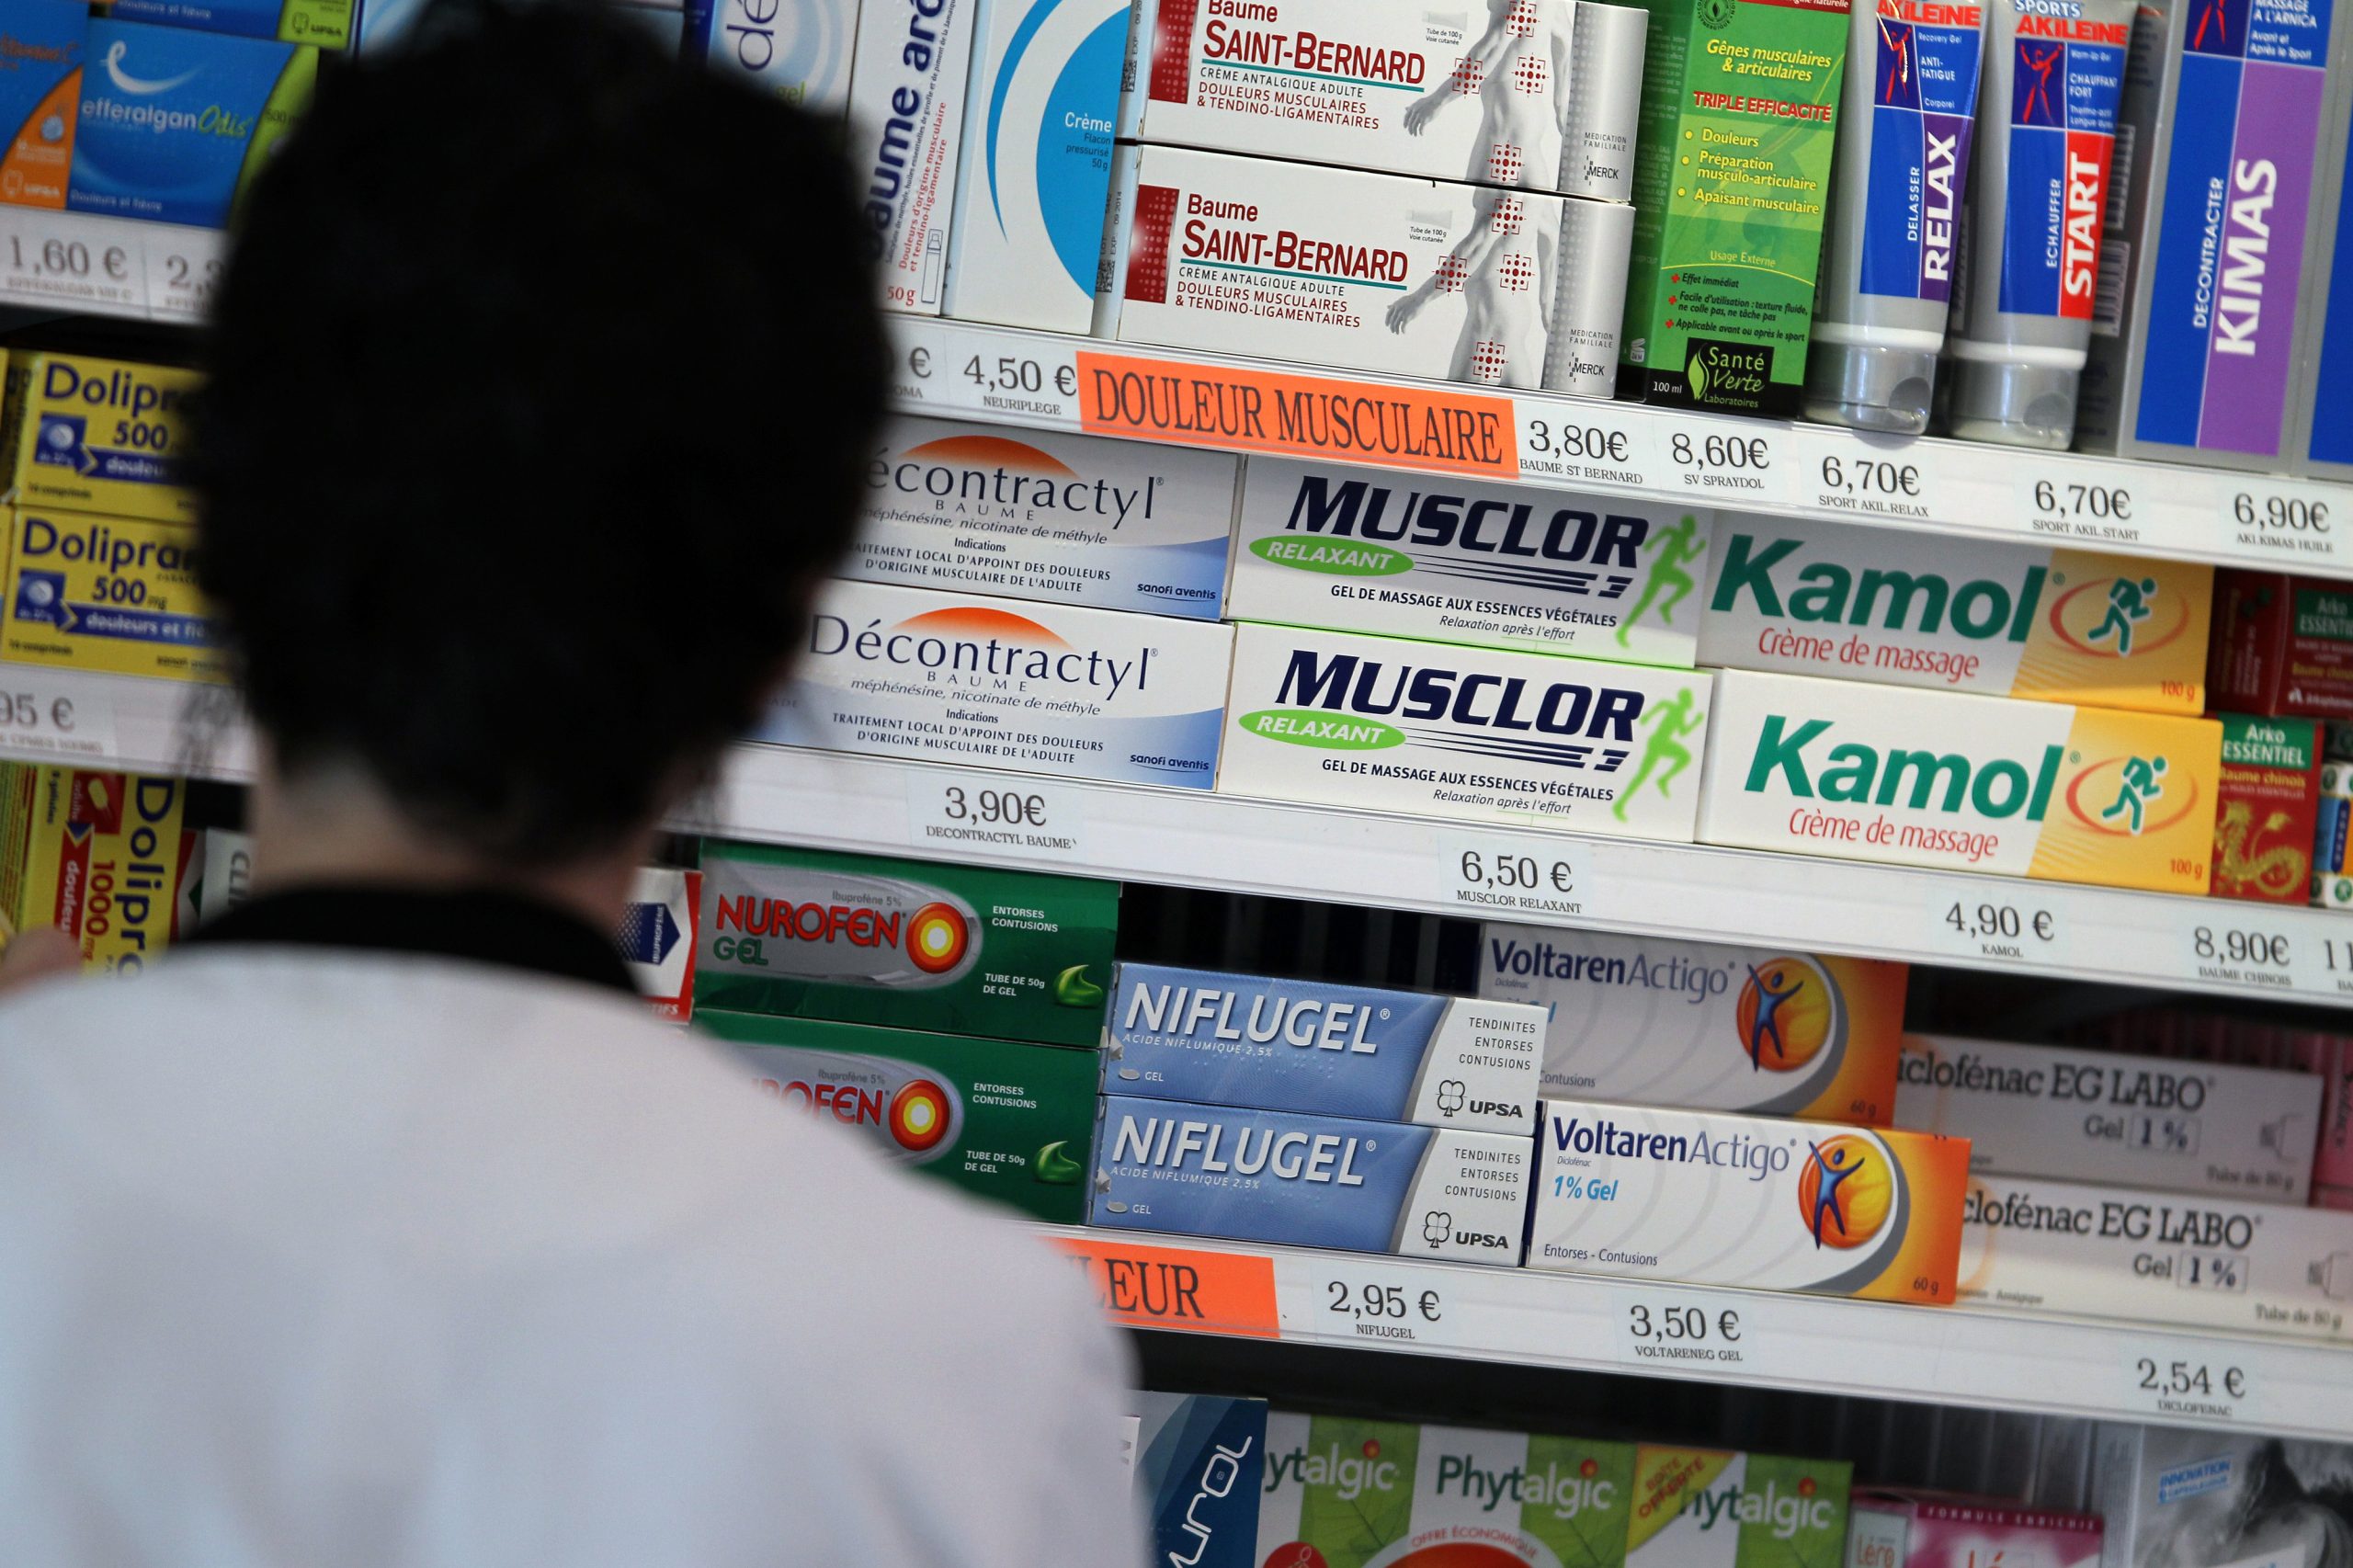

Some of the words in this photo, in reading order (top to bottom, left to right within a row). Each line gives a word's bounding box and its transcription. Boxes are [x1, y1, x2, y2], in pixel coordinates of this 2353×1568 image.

[1203, 20, 1426, 85] SAINT-BERNARD
[1707, 39, 1750, 60] Gênes
[1753, 48, 1832, 68] musculaires
[1722, 58, 1733, 72] &
[1735, 59, 1812, 82] articulaires
[1921, 69, 1955, 82] FATIGUE
[1693, 90, 1745, 111] TRIPLE
[1746, 97, 1833, 122] EFFICACITÉ
[1065, 112, 1112, 132] Crème
[1066, 145, 1108, 156] pressurisé
[1085, 132, 1110, 144] Flacon
[1702, 128, 1759, 147] Douleurs
[1699, 151, 1773, 173] Préparation
[899, 216, 919, 269] Douleurs
[926, 102, 946, 164] musculaire
[1697, 165, 1816, 191] musculo-articulaire
[1187, 193, 1258, 222] Baume
[1694, 188, 1750, 209] Apaisant
[1753, 196, 1819, 215] musculaire
[1906, 165, 1921, 242] DELASSER
[1924, 131, 1957, 282] RELAX
[2046, 178, 2062, 268] ECHAUFFER
[2065, 151, 2100, 299] START
[11, 235, 90, 275] 1,60
[103, 246, 128, 280] €
[910, 259, 916, 272] et
[1182, 218, 1408, 284] SAINT-BERNARD
[1710, 250, 1737, 265] Usage
[1740, 251, 1776, 268] Externe
[2193, 176, 2224, 329] DECONTRACTER
[2215, 157, 2278, 357] KIMAS
[1179, 264, 1218, 281] CRÈME
[1222, 271, 1298, 293] ANTALGIQUE
[1301, 281, 1345, 297] ADULTE
[1177, 280, 1251, 301] DOULEURS
[1254, 289, 1347, 313] MUSCULAIRES
[1175, 295, 1185, 308] &
[1188, 297, 1360, 328] TENDINO-LIGAMENTAIRES
[1569, 336, 1613, 349] FAMILIALE
[1570, 328, 1614, 341] MEDICATION
[1573, 362, 1606, 377] MERCK
[1708, 347, 1765, 371] Santé
[963, 354, 1042, 392] 4,50
[1054, 365, 1077, 396] €
[1711, 367, 1765, 393] Verte
[983, 395, 1062, 415] NEURIPLEGE
[1704, 392, 1759, 409] Laboratoires
[1093, 368, 1267, 440] DOULEUR
[1274, 389, 1503, 465] MUSCULAIRE
[1529, 420, 1629, 462] 3,80€
[1672, 433, 1770, 471] 8,60€
[1519, 459, 1563, 475] BAUME
[1566, 463, 1581, 476] ST
[1584, 465, 1643, 484] BERNARD
[1684, 473, 1699, 485] SV
[1703, 475, 1765, 490] SPRAYDOL
[1823, 456, 1921, 497] 6,70€
[1818, 494, 1858, 509] SPORT
[2035, 480, 2131, 520] 6,70€
[2234, 493, 2331, 533] 6,90€
[1286, 475, 1650, 569] MUSCLOR
[2032, 519, 2071, 534] SPORT
[2298, 540, 2334, 553] HUILE
[92, 577, 145, 607] 500
[1710, 533, 2048, 643] Kamol
[809, 612, 1150, 702] Décontractyl
[926, 670, 1028, 693] BAUME
[1275, 649, 1645, 743] MUSCLOR
[850, 676, 948, 699] méphénésine,
[951, 688, 1021, 708] nicotinate
[1025, 694, 1041, 709] de
[1044, 696, 1101, 718] méthyle
[945, 708, 999, 724] Indications
[1256, 714, 1386, 744] RELAXANT
[833, 711, 904, 733] TRAITEMENT
[907, 721, 945, 735] LOCAL
[949, 724, 1013, 742] D'APPOINT
[1017, 731, 1038, 744] DES
[1041, 733, 1104, 752] DOULEURS
[2245, 723, 2286, 744] Arko
[858, 730, 921, 747] D'ORIGINE
[924, 736, 999, 756] MUSCULAIRE
[1002, 744, 1017, 756] DE
[1018, 746, 1076, 764] L'ADULTE
[1130, 752, 1166, 767] sanofi
[1168, 756, 1210, 770] aventis
[2222, 740, 2305, 767] ESSENTIEL
[1322, 758, 1347, 773] GEL
[1350, 762, 1367, 775] DE
[1370, 764, 1436, 783] MASSAGE
[1439, 770, 1466, 786] AUX
[1470, 774, 1538, 794] ESSENCES
[1540, 778, 1614, 801] VÉGÉTALES
[1745, 714, 2065, 822] Kamol
[944, 786, 1048, 827] 3,90€
[1433, 789, 1495, 806] Relaxation
[1496, 796, 1529, 813] après
[1531, 797, 1572, 815] l'effort
[926, 824, 1024, 846] DECONTRACTYL
[1026, 834, 1072, 849] BAUME
[1789, 808, 1861, 843] Crème
[1866, 816, 1894, 846] de
[1899, 826, 1999, 864] massage
[1461, 849, 1540, 890] 6,50
[1551, 860, 1574, 894] €
[85, 859, 116, 936] 1000
[1456, 890, 1517, 908] MUSCLOR
[1518, 895, 1582, 914] RELAXANT
[715, 892, 899, 949] NUROFEN
[992, 905, 1045, 920] ENTORSES
[992, 917, 1059, 933] CONTUSIONS
[1945, 902, 2022, 938] 4,90
[2033, 910, 2055, 941] €
[711, 935, 769, 966] GEL
[1982, 943, 2023, 959] KAMOL
[2194, 926, 2290, 967] 8,90€
[2199, 966, 2241, 983] BAUME
[2244, 971, 2291, 987] CHINOIS
[1124, 982, 1378, 1055] NIFLUGEL
[1468, 1017, 1536, 1034] TENDINITES
[1122, 1032, 1162, 1046] ACIDE
[1164, 1036, 1242, 1057] NIFLUMIQUE
[1474, 1036, 1534, 1053] ENTORSES
[1459, 1053, 1531, 1071] CONTUSIONS
[1470, 1100, 1524, 1119] UPSA
[1112, 1114, 1365, 1187] NIFLUGEL
[1553, 1176, 1583, 1198] 1%
[1586, 1177, 1619, 1201] Gel
[2098, 1200, 2152, 1240] EG
[2158, 1207, 2253, 1251] LABO
[1543, 1244, 1588, 1261] Entorses
[1598, 1249, 1658, 1267] Contusions
[1328, 1280, 1407, 1319] 2,95
[1418, 1290, 1442, 1323] €
[1356, 1323, 1415, 1341] NIFLUGEL
[1630, 1304, 1707, 1343] 3,50
[1718, 1310, 1742, 1341] €
[1635, 1345, 1715, 1360] VOLTARENEG
[1719, 1348, 1743, 1361] GEL
[2137, 1358, 2212, 1396] 2,54
[2224, 1368, 2246, 1399] €
[2157, 1399, 2233, 1417] DICLOFENAC
[1436, 1454, 1613, 1519] Phytalgic
